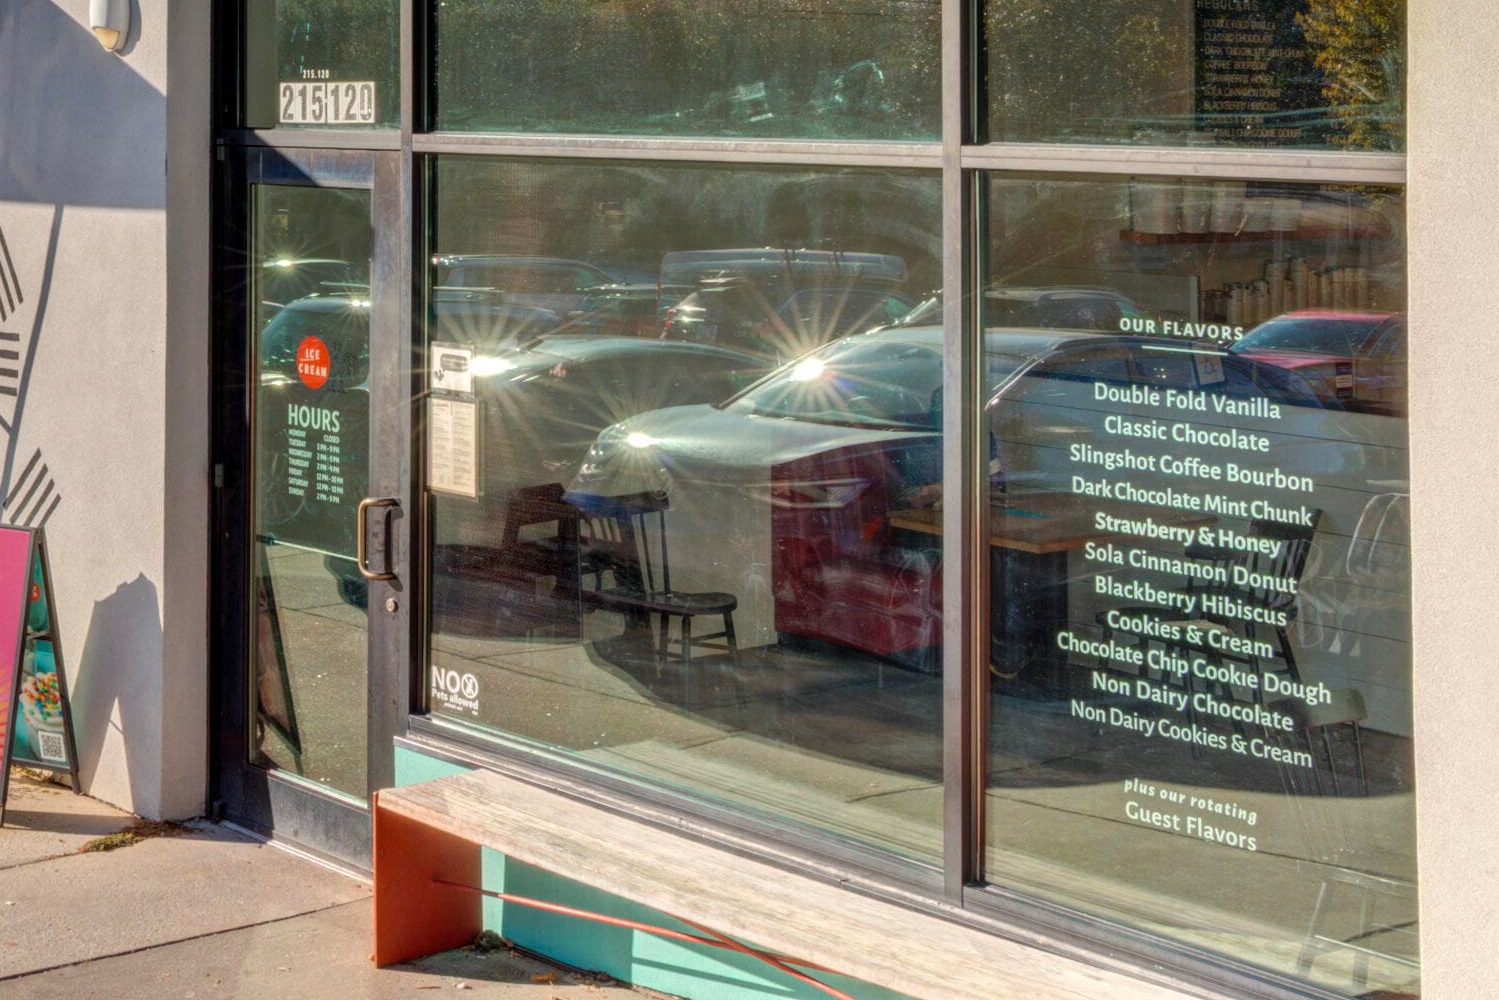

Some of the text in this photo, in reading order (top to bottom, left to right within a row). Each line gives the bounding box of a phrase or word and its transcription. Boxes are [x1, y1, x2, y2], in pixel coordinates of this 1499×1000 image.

[1119, 317, 1244, 340] OUR FLAVORS
[298, 364, 328, 378] CREAM
[305, 348, 320, 360] ICE
[288, 403, 340, 432] HOURS
[1094, 382, 1281, 420] Double Fold Vanilla
[1104, 415, 1270, 452] Classic Chocolate
[1070, 444, 1314, 492] Slingshot Coffee Bourbon
[1072, 475, 1313, 527] Dark Chocolate Mint Chunk
[1095, 512, 1281, 558] Strawberry & Honey
[1085, 542, 1298, 594] Sola Cinnamon Donut
[1095, 575, 1287, 627] Blackberry Hibiscus
[1107, 610, 1273, 658] Cookies & Cream
[432, 665, 460, 693] NO
[1057, 632, 1332, 705] Chocolate Chip Cookie Dough
[432, 687, 448, 701] Pets
[449, 694, 479, 710] allowed
[1092, 671, 1294, 731] Non Dairy Chocolate
[1071, 699, 1313, 768] Non Dairy Cookies & Cream
[1124, 777, 1257, 825] plus our rotating
[1125, 801, 1257, 851] Guest Flavors
